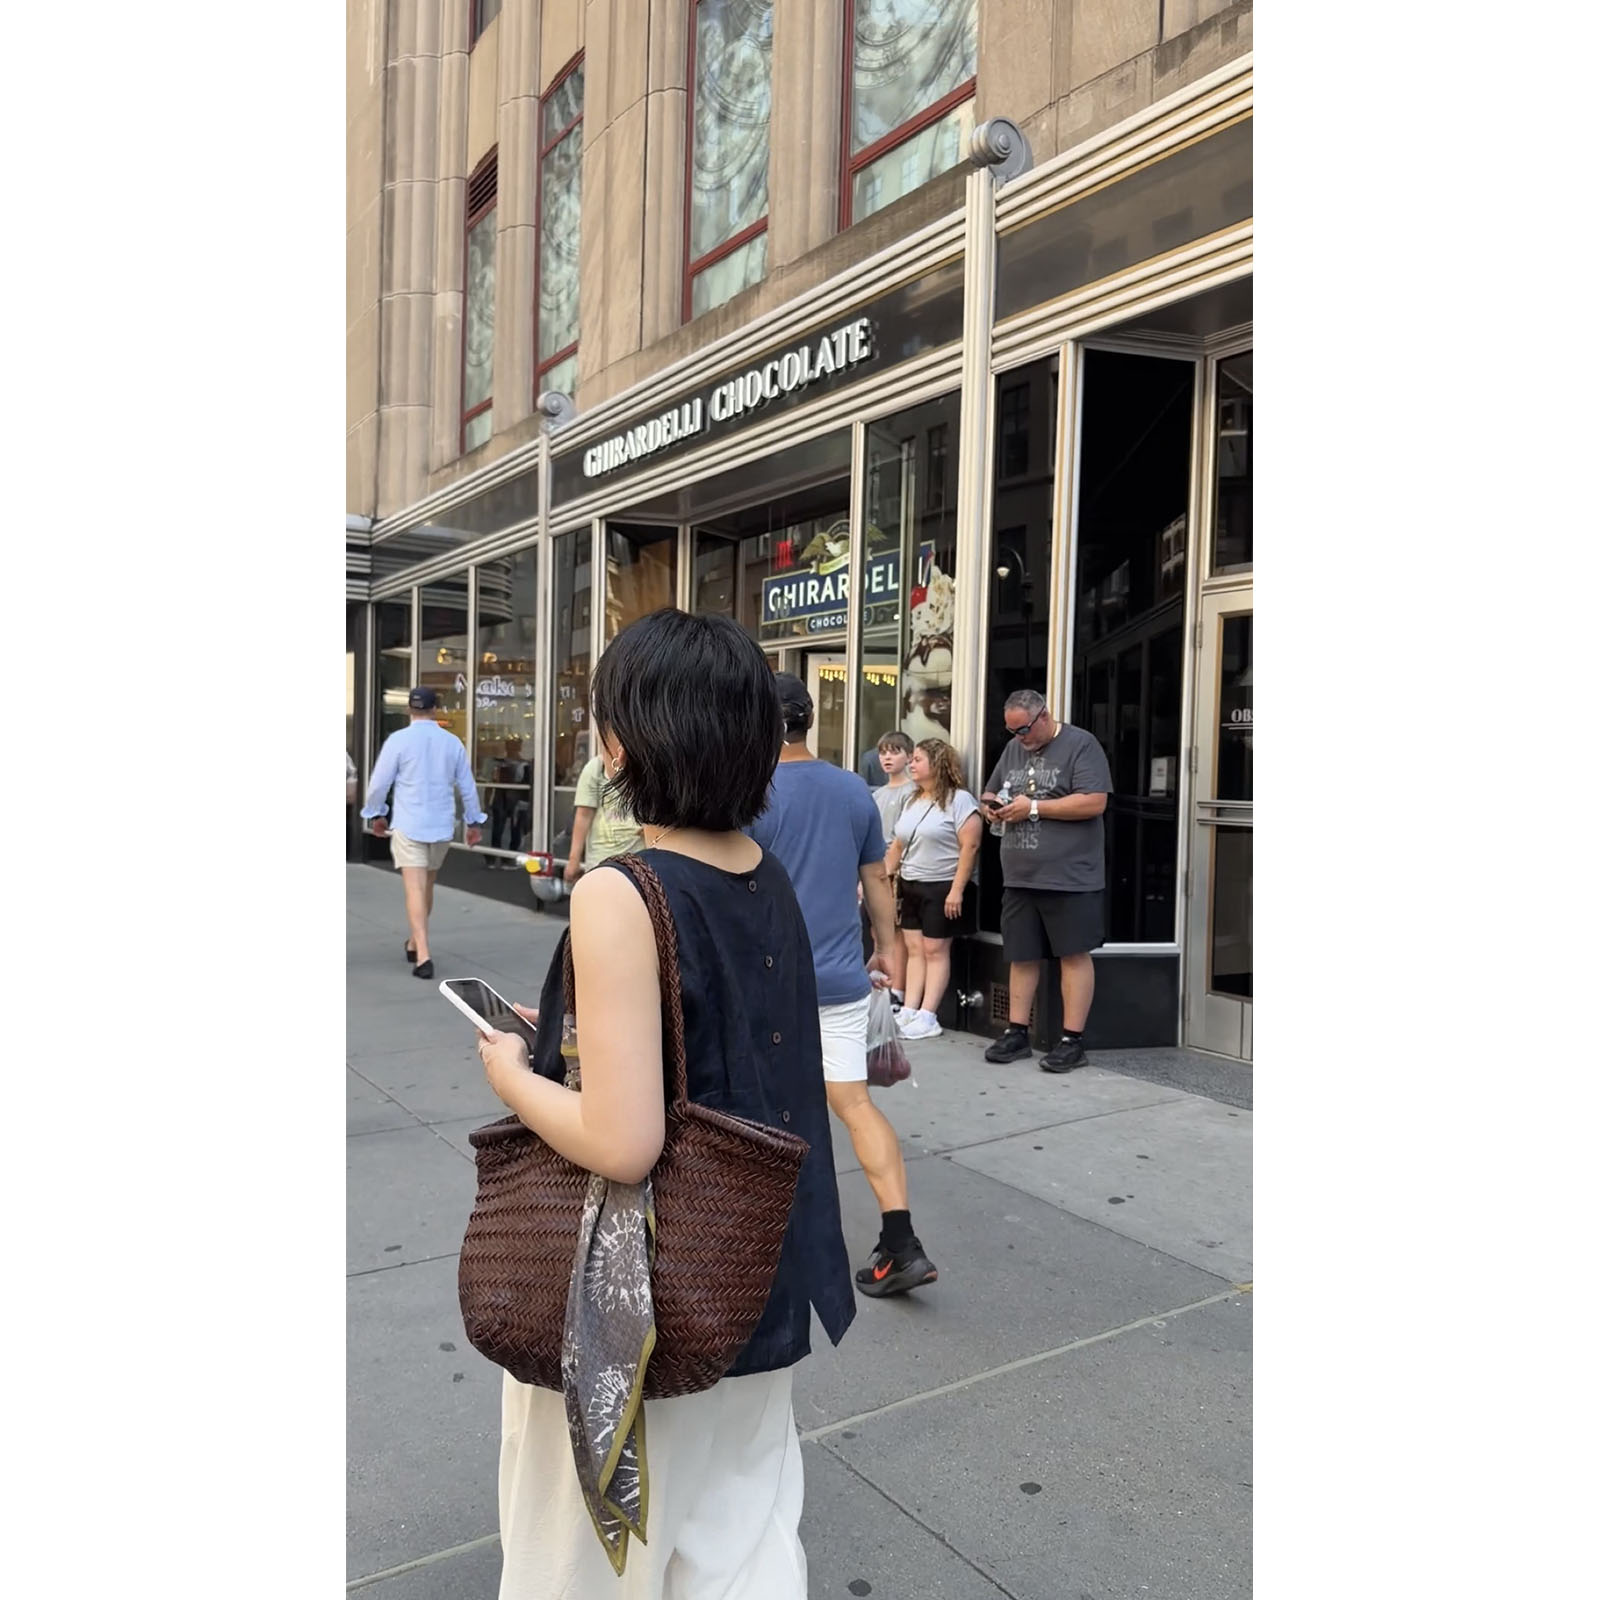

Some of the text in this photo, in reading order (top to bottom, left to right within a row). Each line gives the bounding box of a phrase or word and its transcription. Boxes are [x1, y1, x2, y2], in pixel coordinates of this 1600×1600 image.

[583, 317, 871, 478] GHIRARDELLI CHOCOLATE
[1231, 708, 1253, 723] OB
